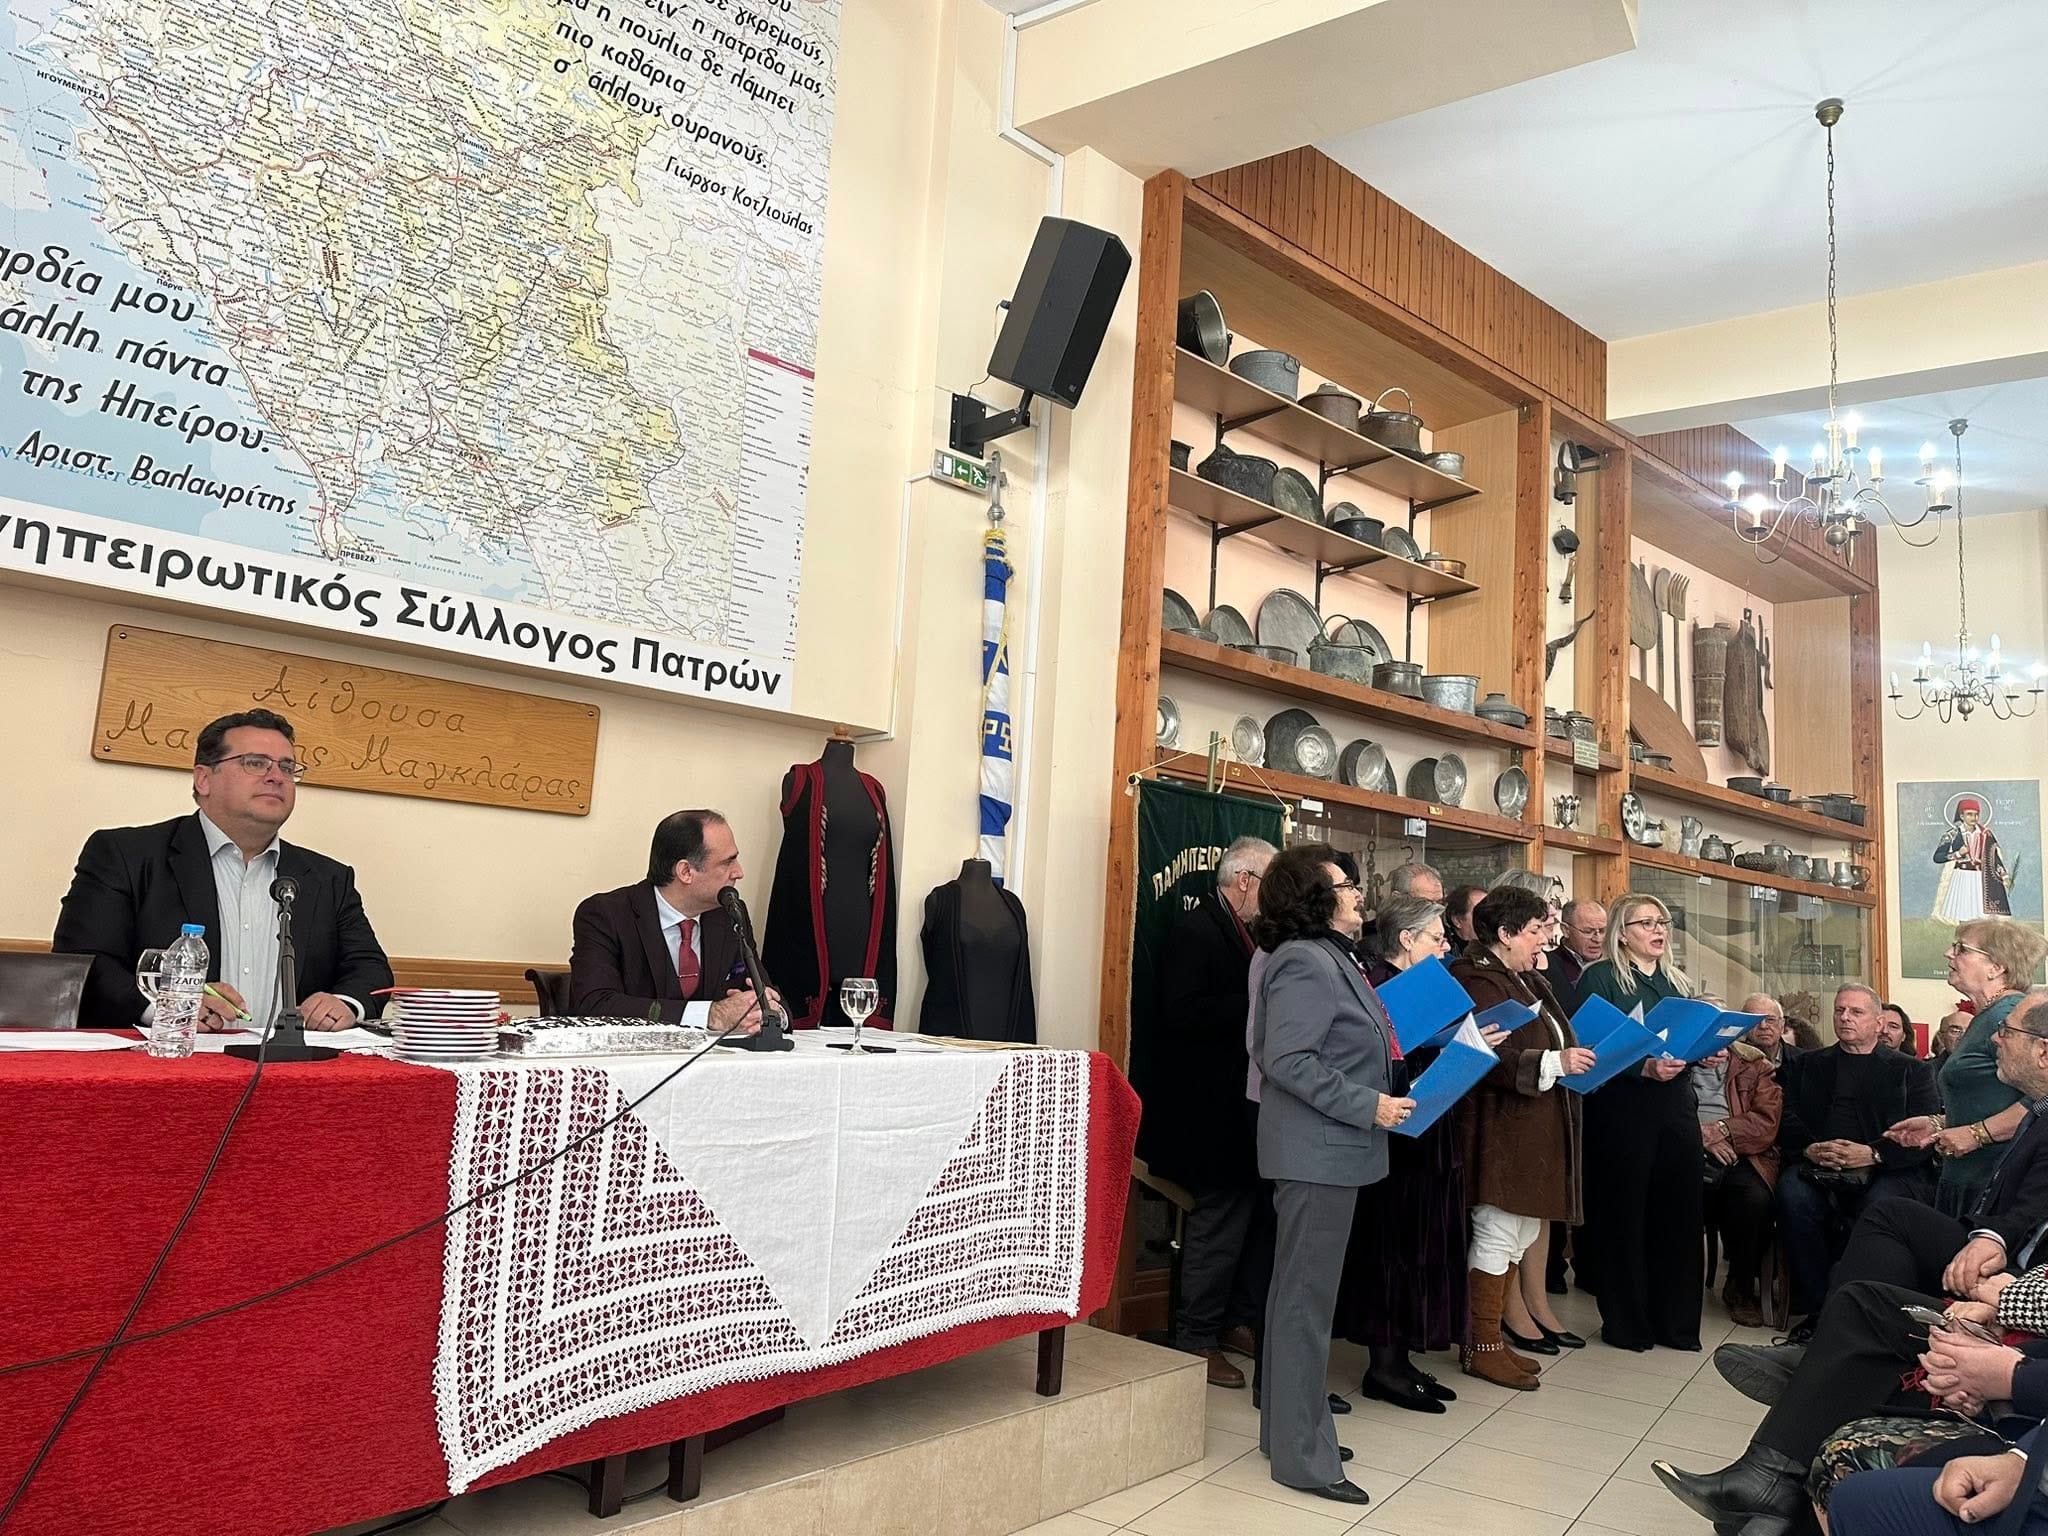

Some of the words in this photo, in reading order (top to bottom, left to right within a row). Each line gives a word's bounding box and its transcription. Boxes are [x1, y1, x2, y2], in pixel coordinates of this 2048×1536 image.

[556, 22, 594, 49] πιο
[601, 44, 686, 94] καθάρια
[597, 5, 611, 22] η
[619, 16, 693, 61] πούλια
[701, 49, 724, 77] δε
[730, 68, 796, 114] λάμπει
[692, 18, 705, 34] η
[712, 29, 786, 75] πατρίδα
[789, 70, 825, 99] μας,
[735, 7, 824, 65] γκρεμούς,
[36, 70, 105, 100] ΗΓΟΥΜΕΝΙΤΣΑ
[588, 70, 664, 118] άλλους
[671, 113, 767, 169] ουρανούς.
[665, 155, 727, 197] Γιώργος
[732, 186, 813, 235] Κοτζιούλας
[110, 282, 195, 323] μου
[115, 338, 230, 388] πάντα
[22, 368, 83, 405] της
[100, 379, 270, 453] Ηπείρου.
[16, 430, 115, 476] Αριστ.
[130, 454, 297, 515] Βαλαωρίτης
[340, 550, 375, 563] ΠΡΕΒΕΖΑ
[396, 586, 617, 673] Σύλλογος
[632, 638, 782, 695] Πατρών
[252, 664, 466, 734] Αίθουσα
[350, 734, 581, 801] Μαγκλάρας
[1152, 846, 1229, 901] ΠΑΝΗΠΕΙΡ
